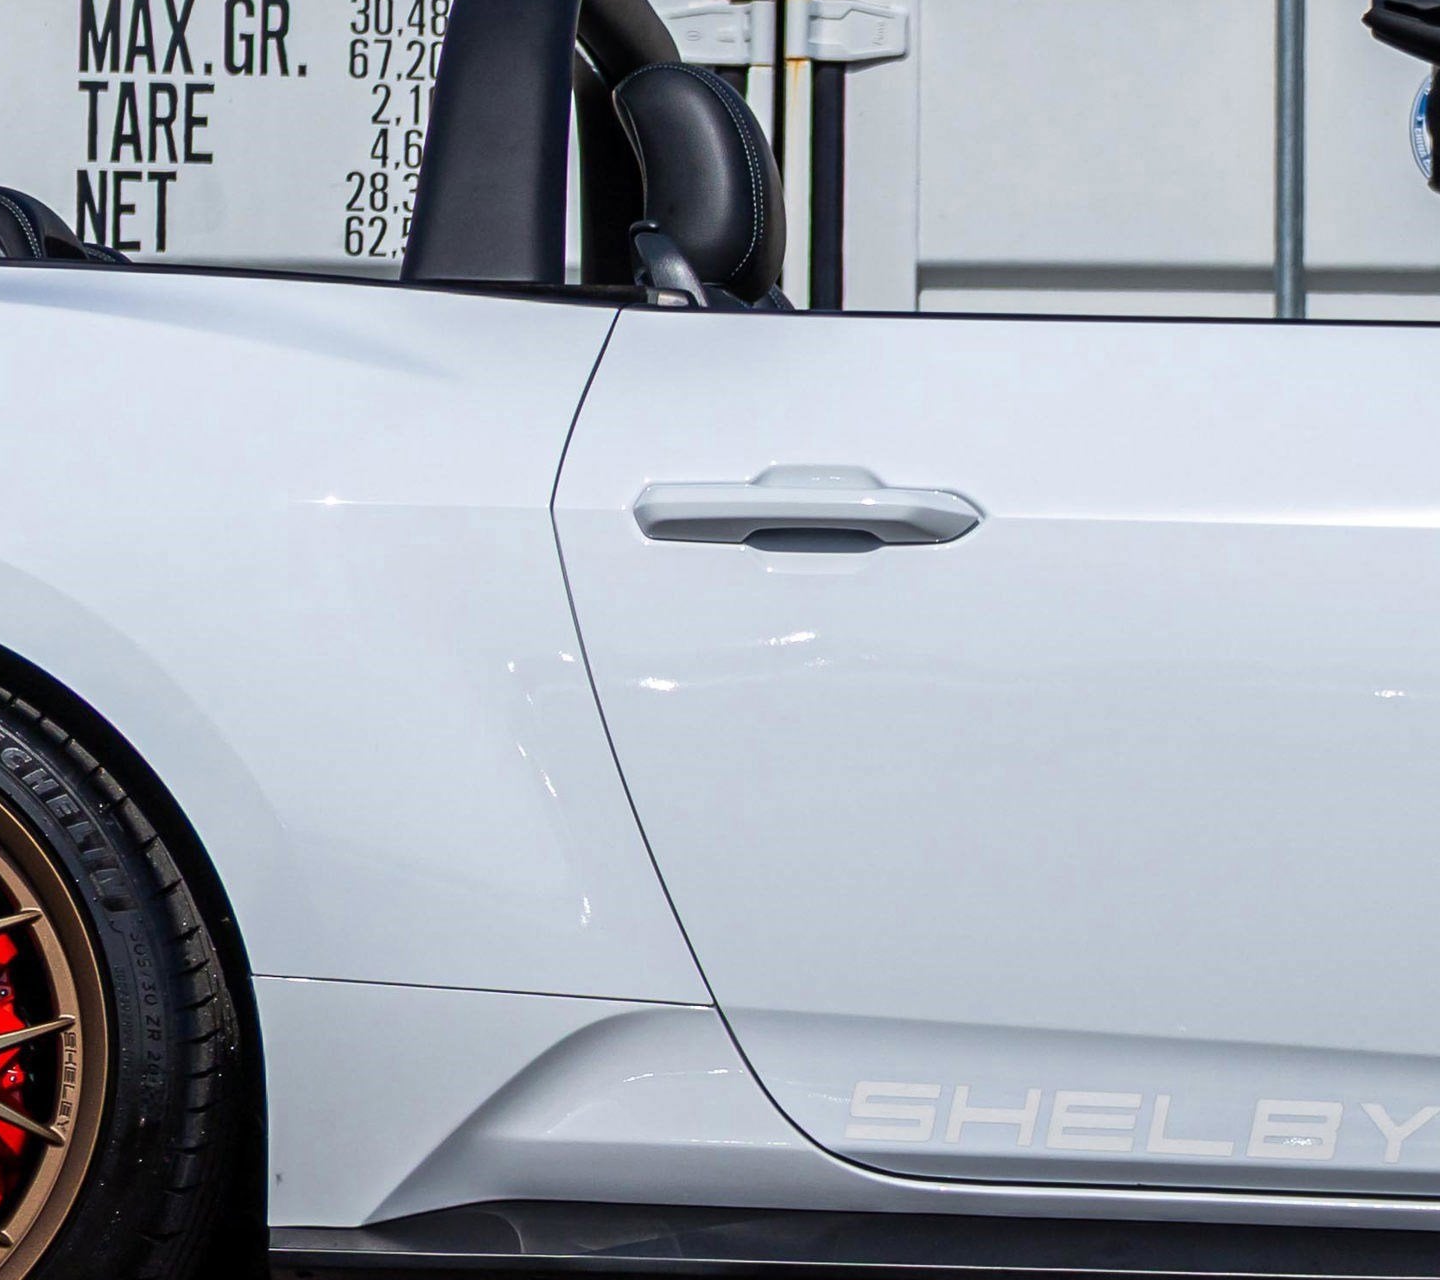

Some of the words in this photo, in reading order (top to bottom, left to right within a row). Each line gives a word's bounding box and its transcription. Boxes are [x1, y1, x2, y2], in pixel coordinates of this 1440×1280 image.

[77, 80, 216, 164] TARE
[371, 83, 434, 126] 2,1
[370, 128, 423, 170] 4,6
[76, 169, 178, 253] NET
[345, 171, 419, 214] 28,3
[57, 1031, 77, 1134] SHELBY
